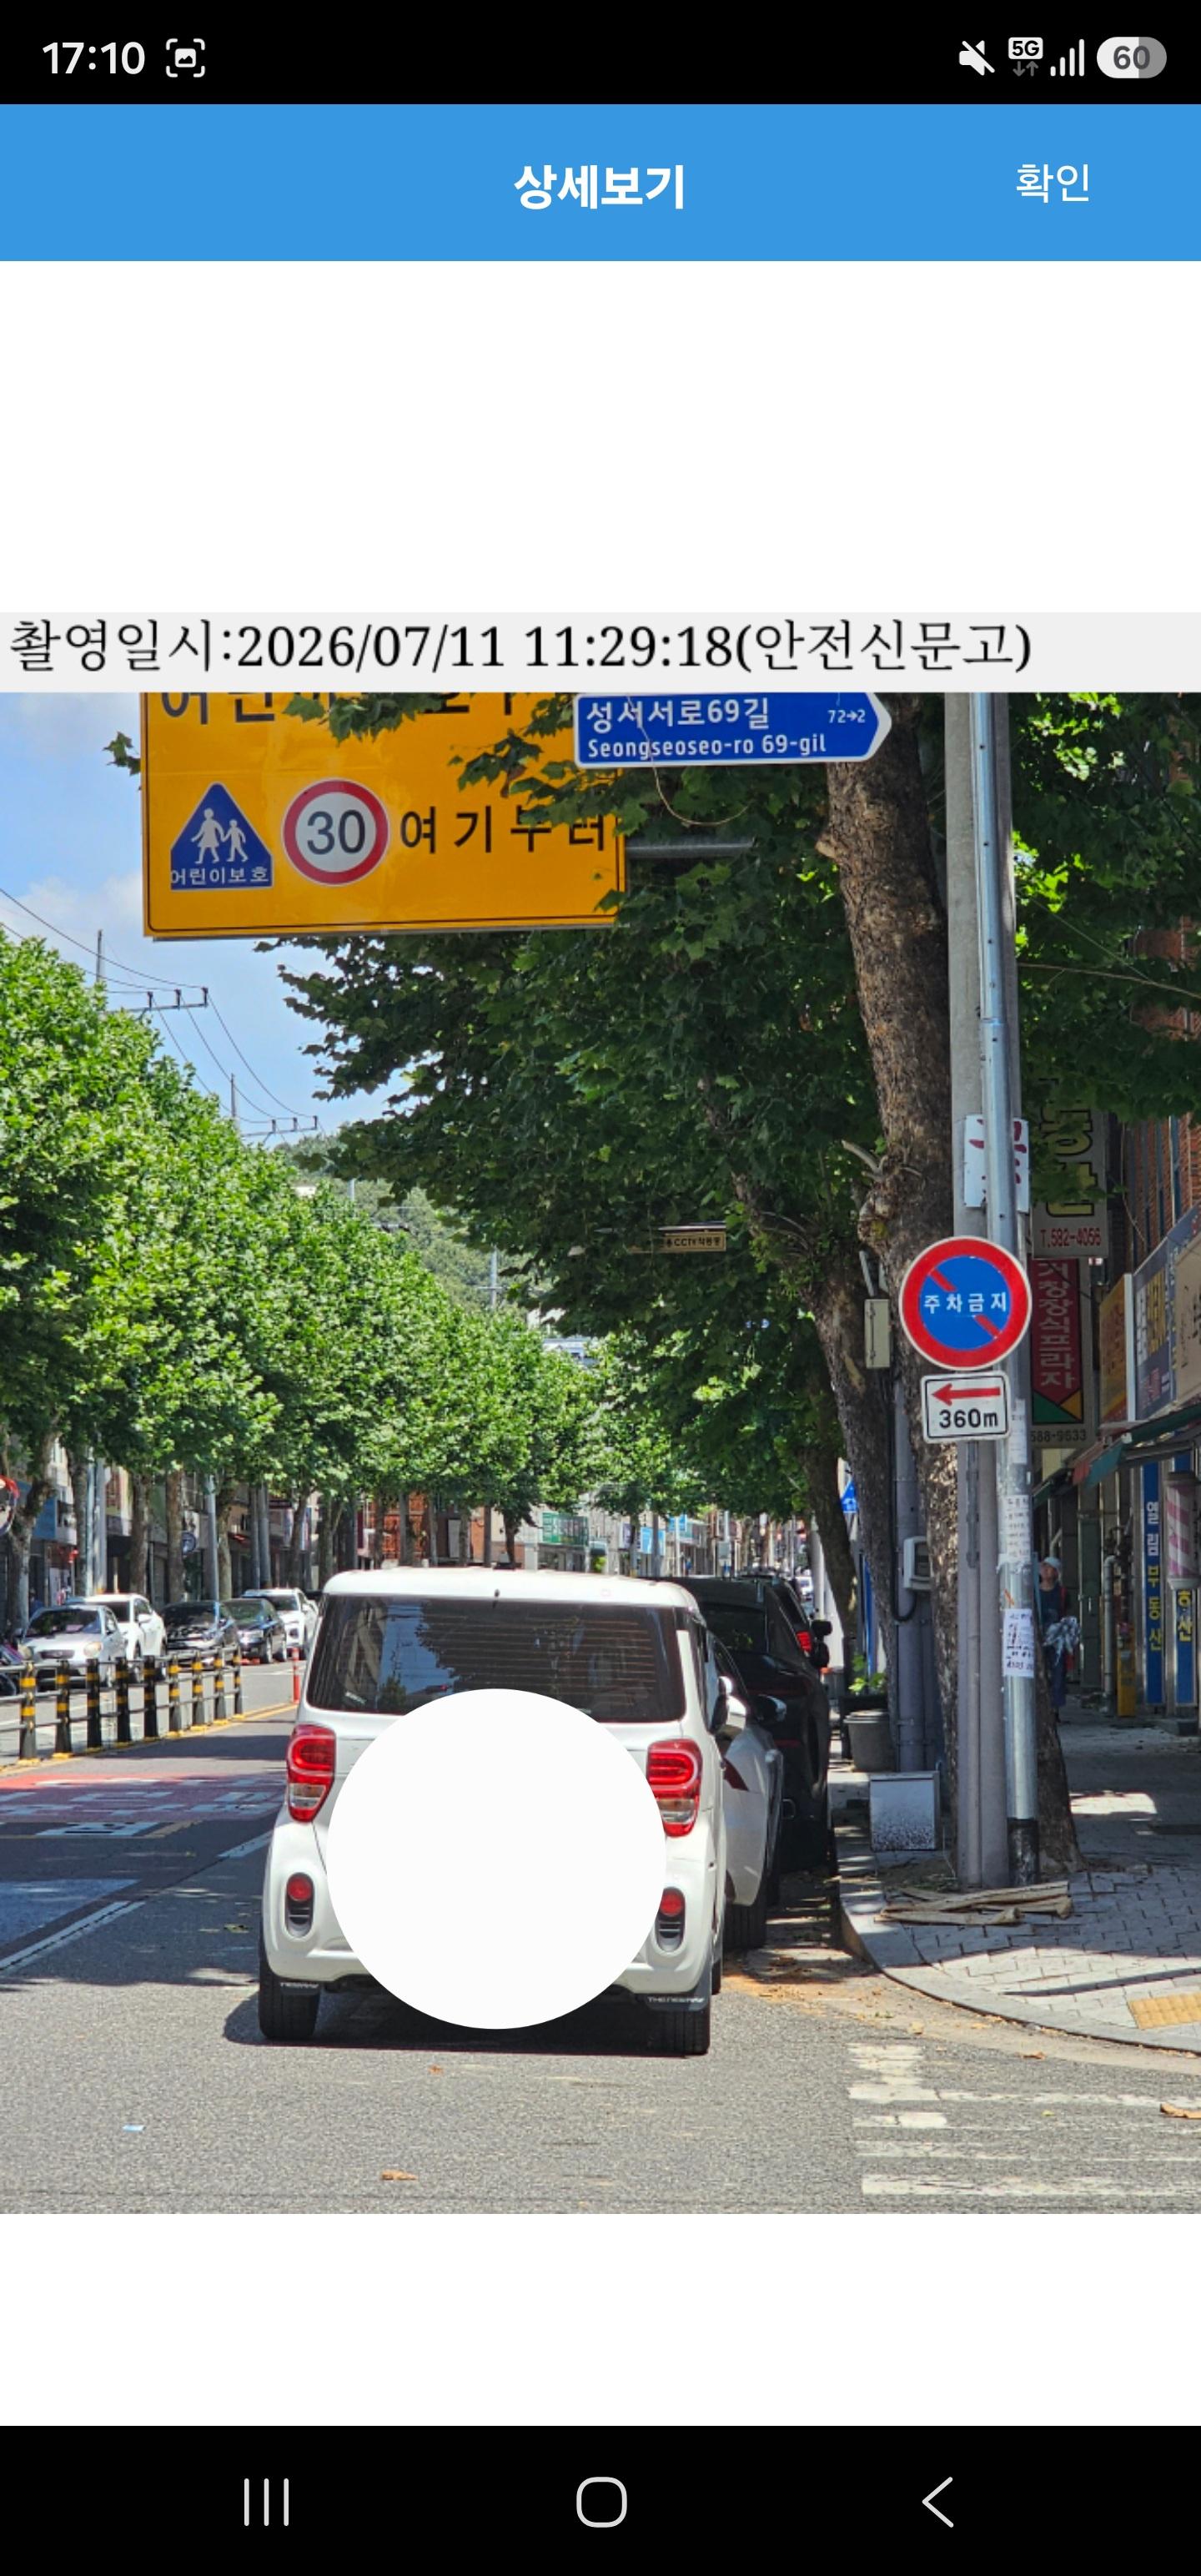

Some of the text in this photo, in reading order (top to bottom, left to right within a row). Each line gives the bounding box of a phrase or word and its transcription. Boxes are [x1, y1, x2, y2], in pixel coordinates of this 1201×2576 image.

[42, 42, 145, 75] 17:10
[1012, 39, 1040, 57] 5G
[1113, 45, 1151, 70] 60
[514, 164, 684, 210] 상세보기
[1016, 164, 1089, 204] 확인
[586, 697, 769, 734] 성서서로69길
[588, 733, 827, 761] Seongseoseo-ro 69-gil
[306, 809, 366, 855] 30
[171, 867, 269, 885] 어린이보호
[924, 1292, 1007, 1314] 주차금지
[939, 1408, 999, 1429] 360m
